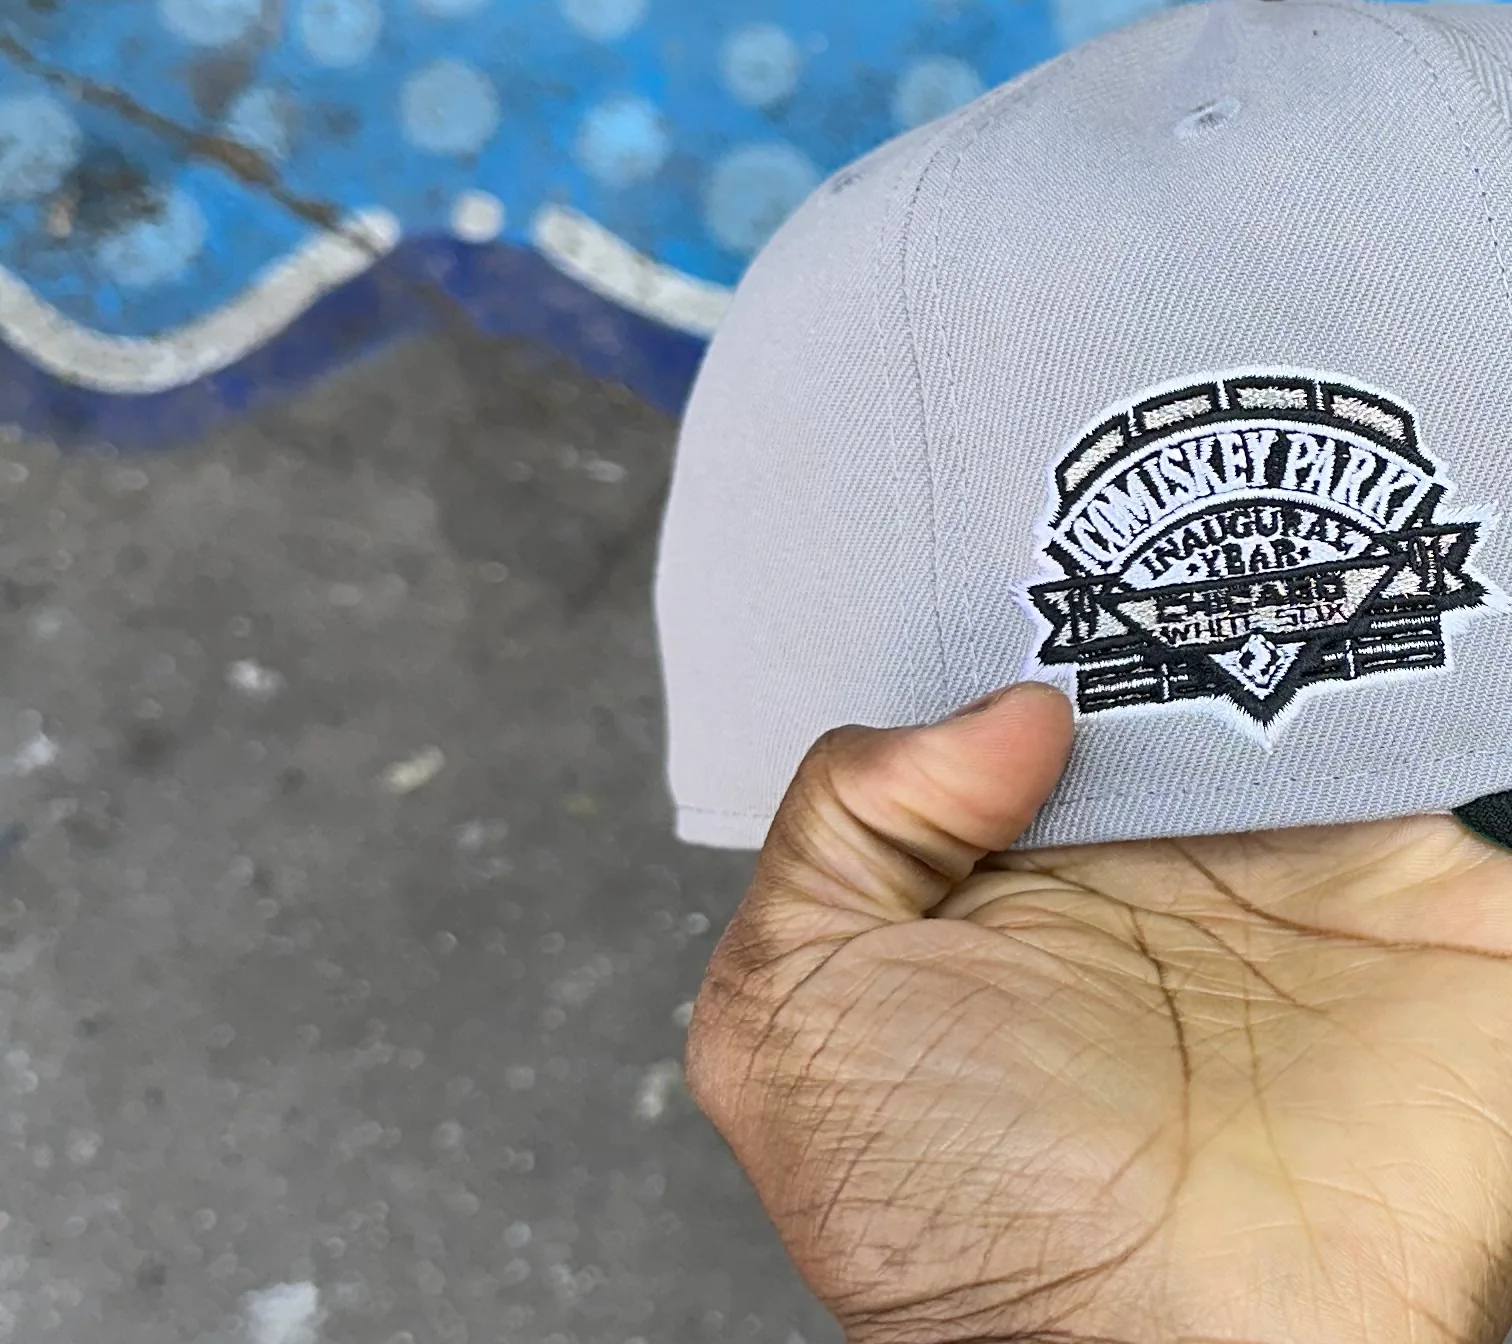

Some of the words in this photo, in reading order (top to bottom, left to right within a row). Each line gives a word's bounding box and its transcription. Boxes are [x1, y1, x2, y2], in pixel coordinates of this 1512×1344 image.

[1072, 429, 1279, 563] COMISKEY
[1279, 433, 1420, 530] PARK
[1140, 506, 1355, 581] INAUGURAL
[1204, 537, 1298, 577] YEAR
[1276, 604, 1350, 630] SOX
